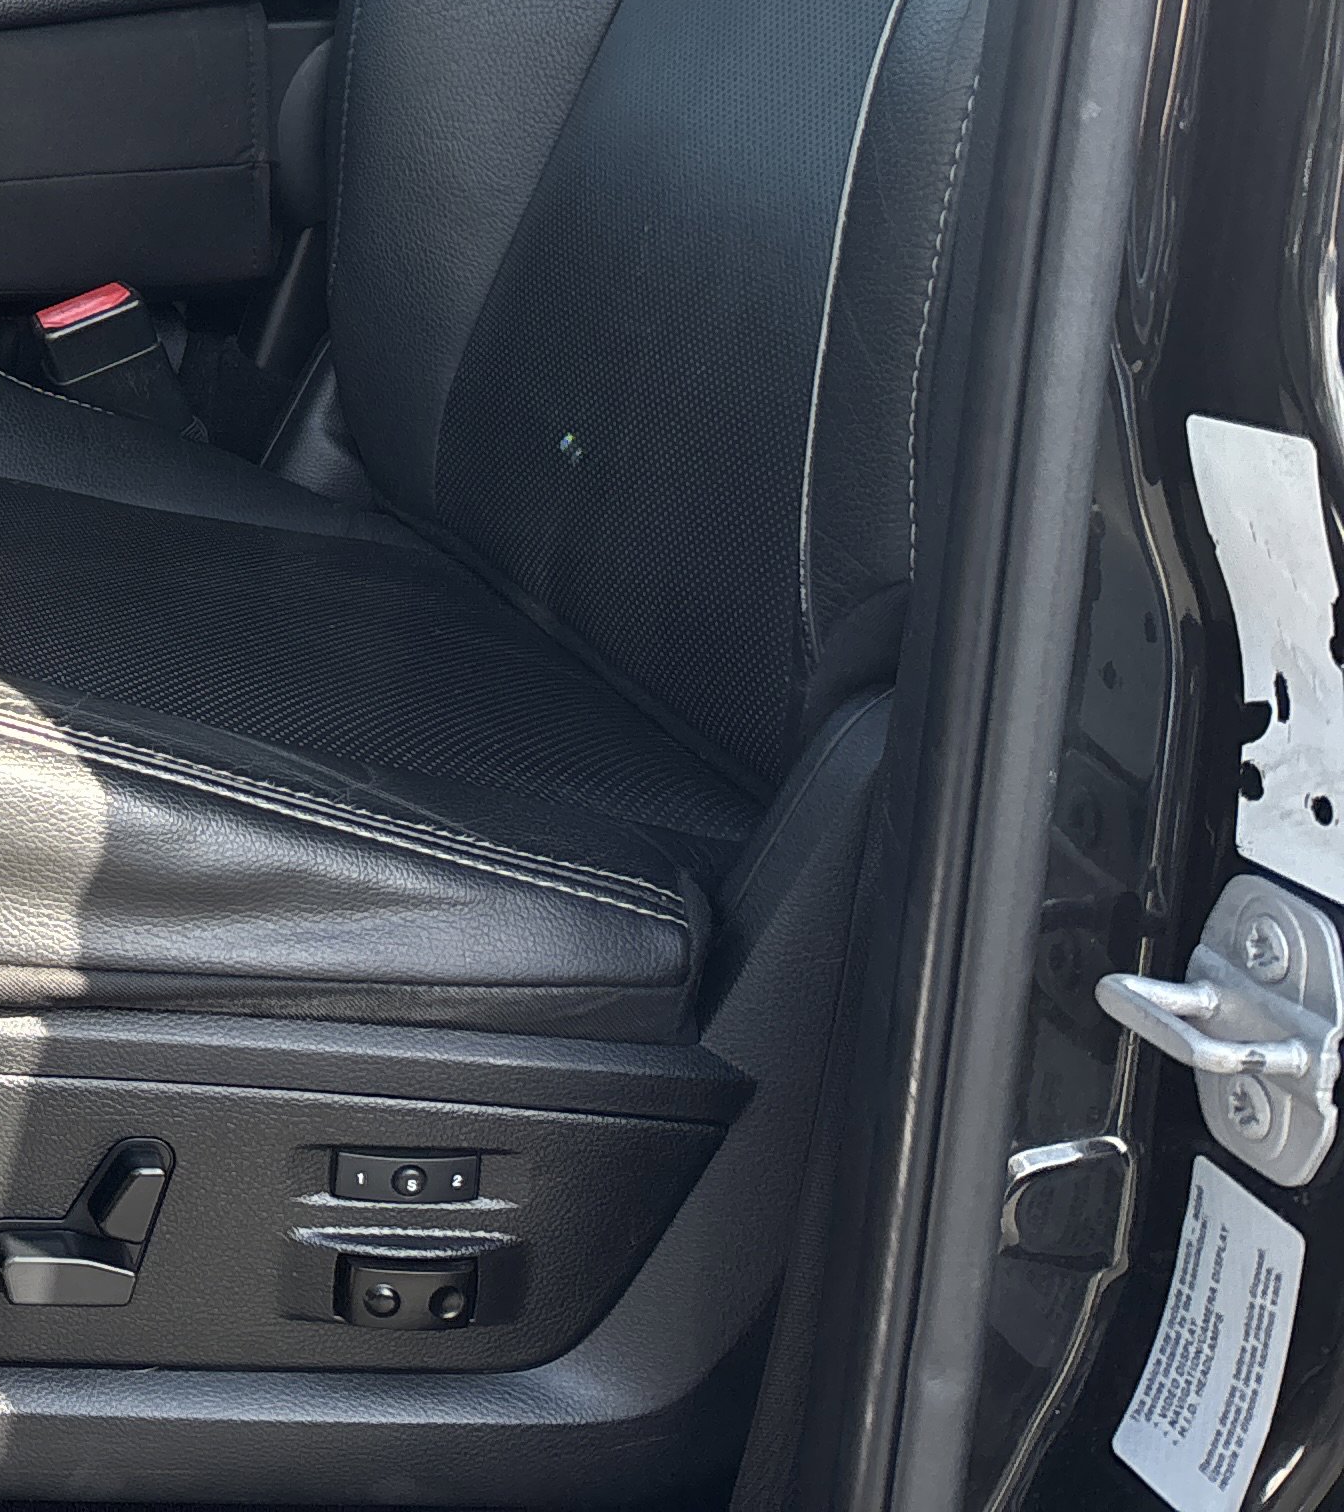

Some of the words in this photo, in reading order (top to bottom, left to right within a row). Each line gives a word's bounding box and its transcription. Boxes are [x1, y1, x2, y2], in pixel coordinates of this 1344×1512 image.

[356, 1171, 365, 1186] 1
[406, 1179, 418, 1192] S
[451, 1174, 463, 1188] 2
